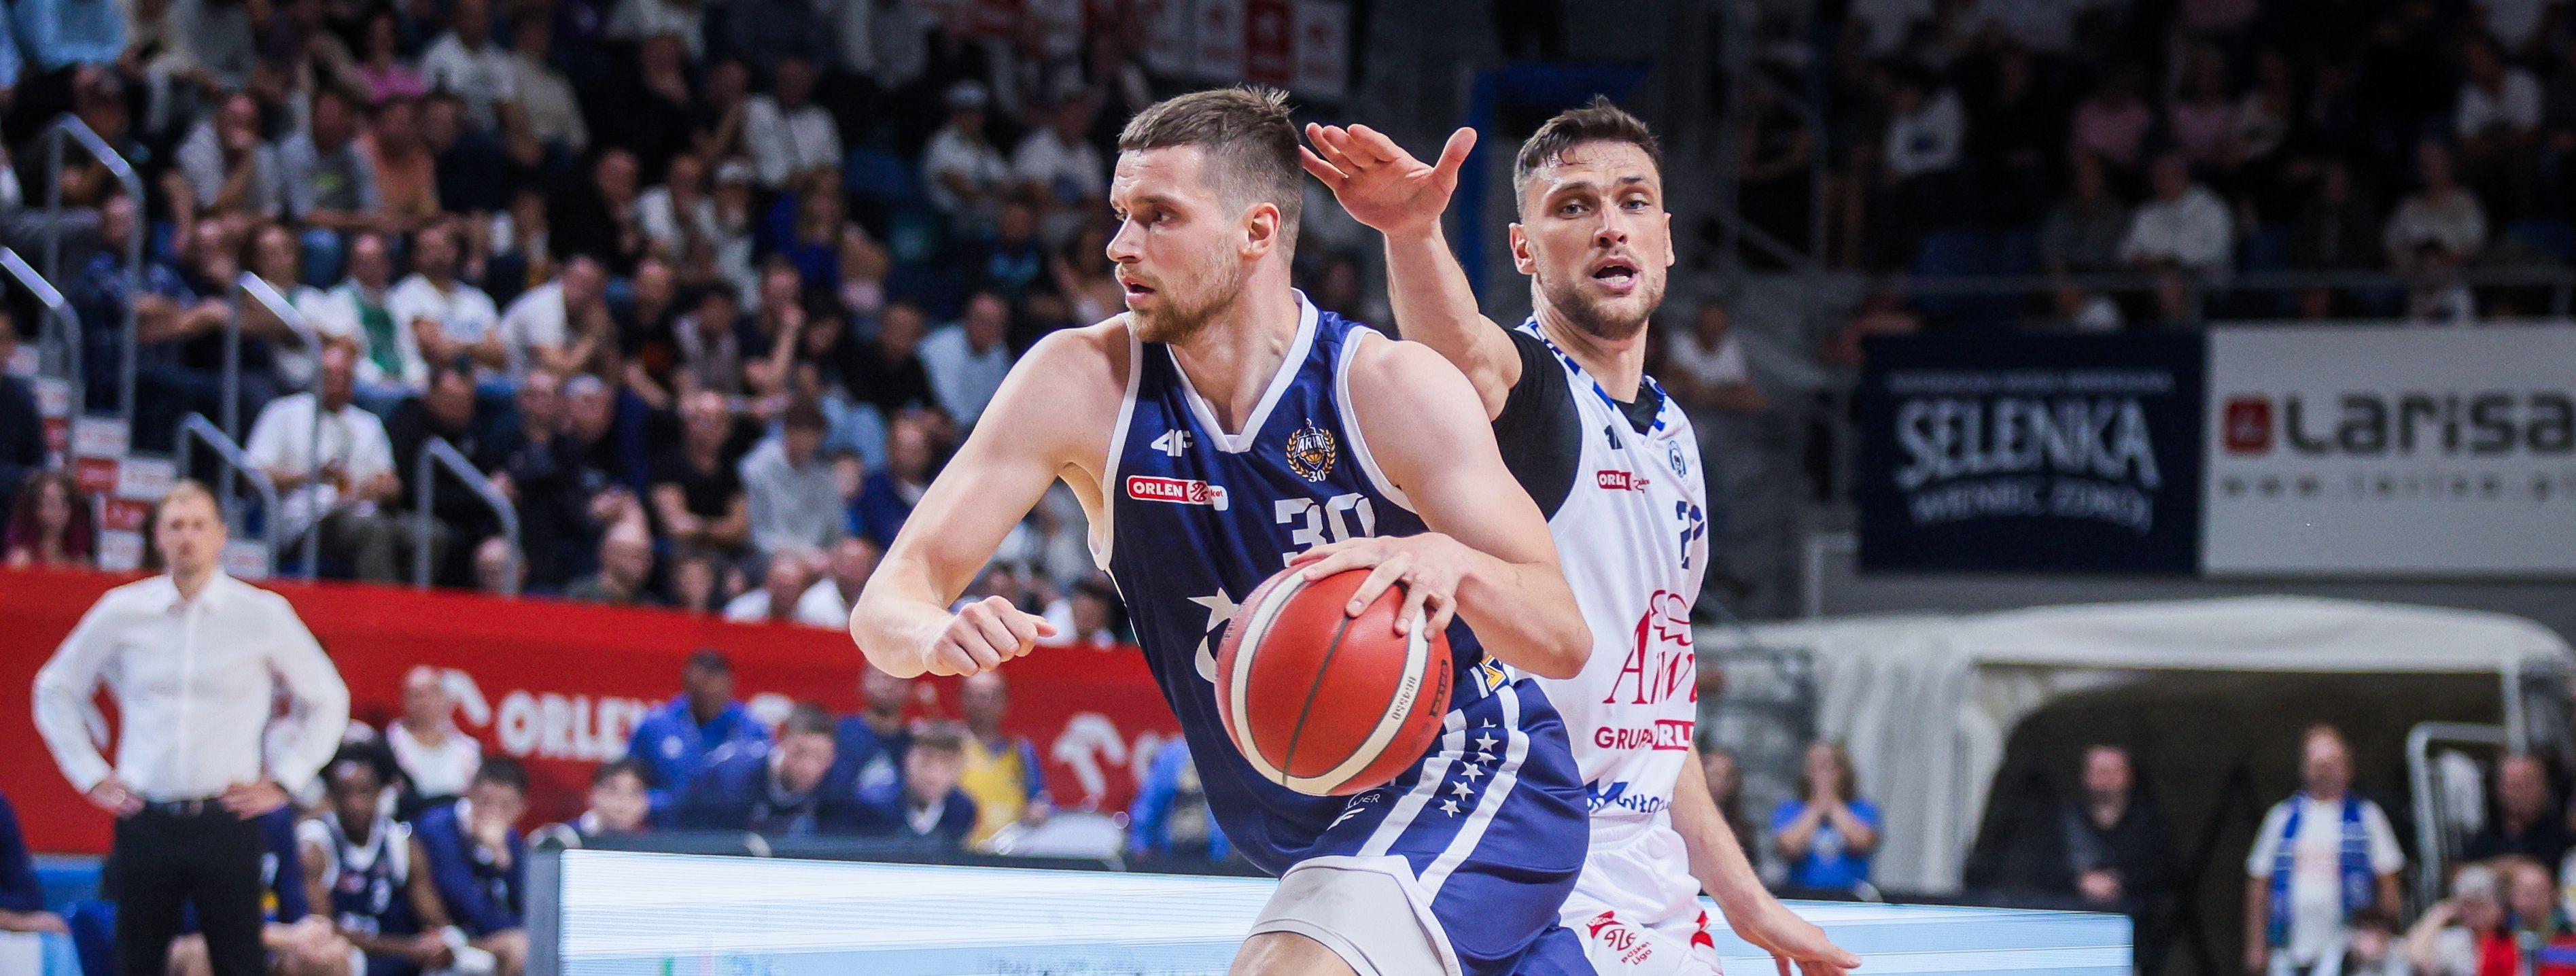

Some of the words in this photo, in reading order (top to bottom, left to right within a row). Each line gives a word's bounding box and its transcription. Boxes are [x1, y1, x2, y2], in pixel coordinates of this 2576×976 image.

[1895, 400, 2160, 489] SELENKA
[1133, 481, 1183, 498] ORLEN
[1210, 488, 1223, 498] ket
[1308, 470, 1326, 482] 30
[1274, 492, 1376, 568] 30
